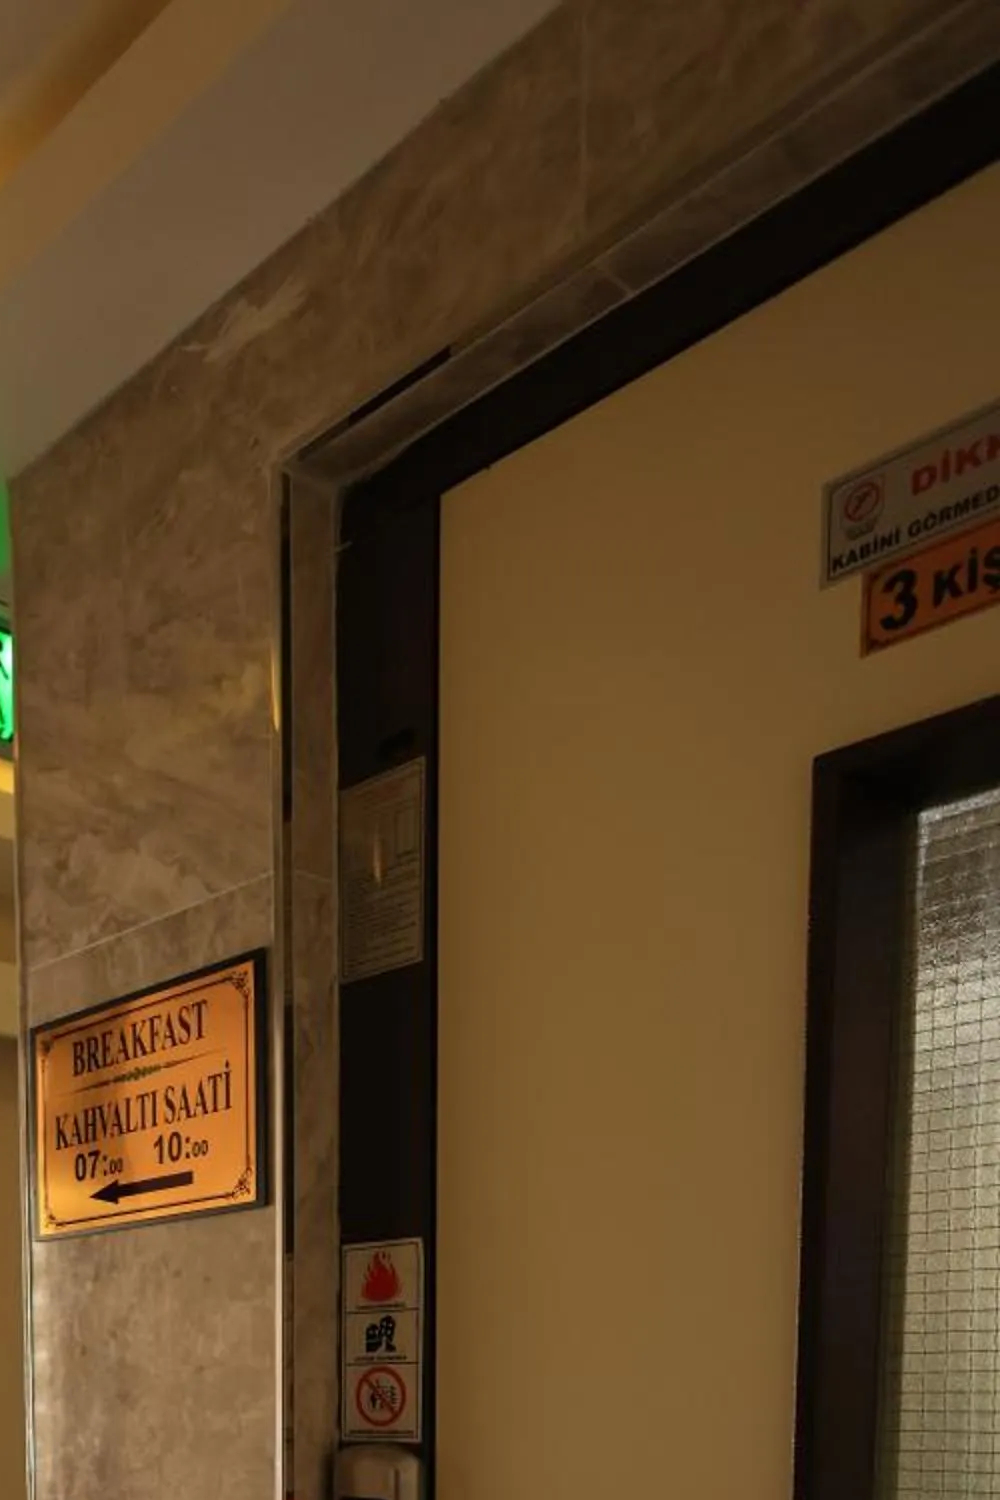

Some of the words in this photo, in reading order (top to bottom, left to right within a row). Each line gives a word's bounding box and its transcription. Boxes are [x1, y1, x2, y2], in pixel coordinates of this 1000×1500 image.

[880, 568, 918, 631] 3
[72, 1000, 208, 1077] BREAKFAST
[55, 1090, 158, 1151] KAHVALTI
[164, 1060, 233, 1125] SAATİ
